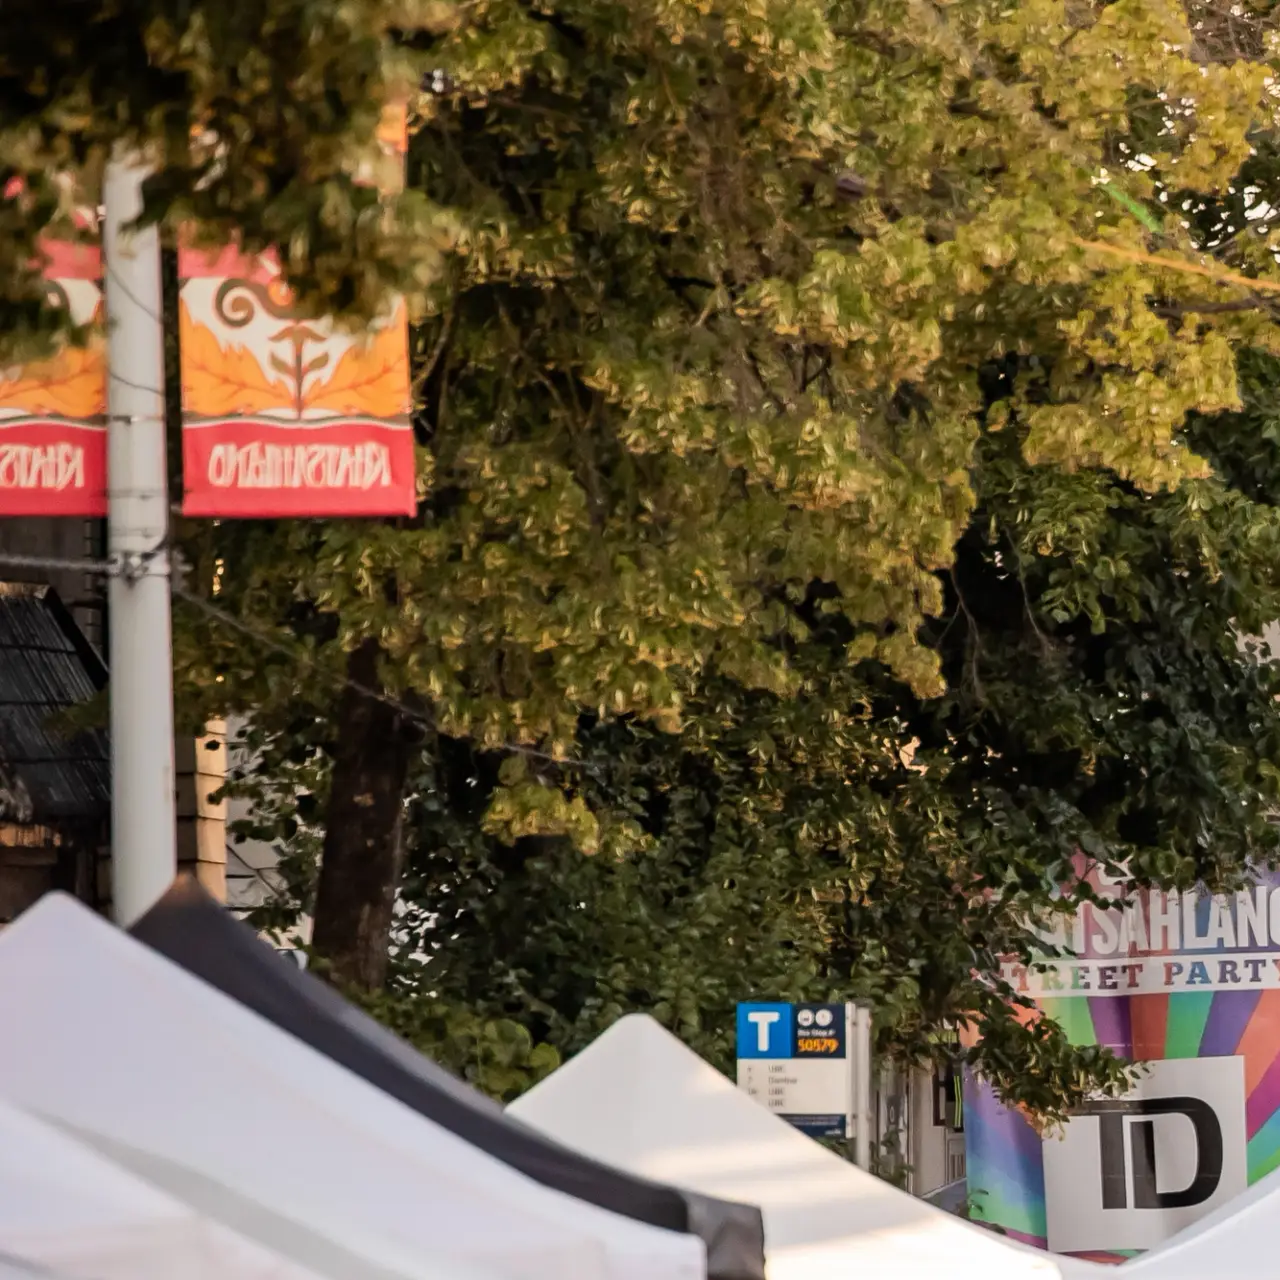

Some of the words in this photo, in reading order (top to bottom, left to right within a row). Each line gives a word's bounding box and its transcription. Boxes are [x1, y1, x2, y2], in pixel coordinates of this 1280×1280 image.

[1000, 963, 1144, 992] TREET
[747, 1011, 780, 1052] T
[1066, 1096, 1224, 1210] TD
